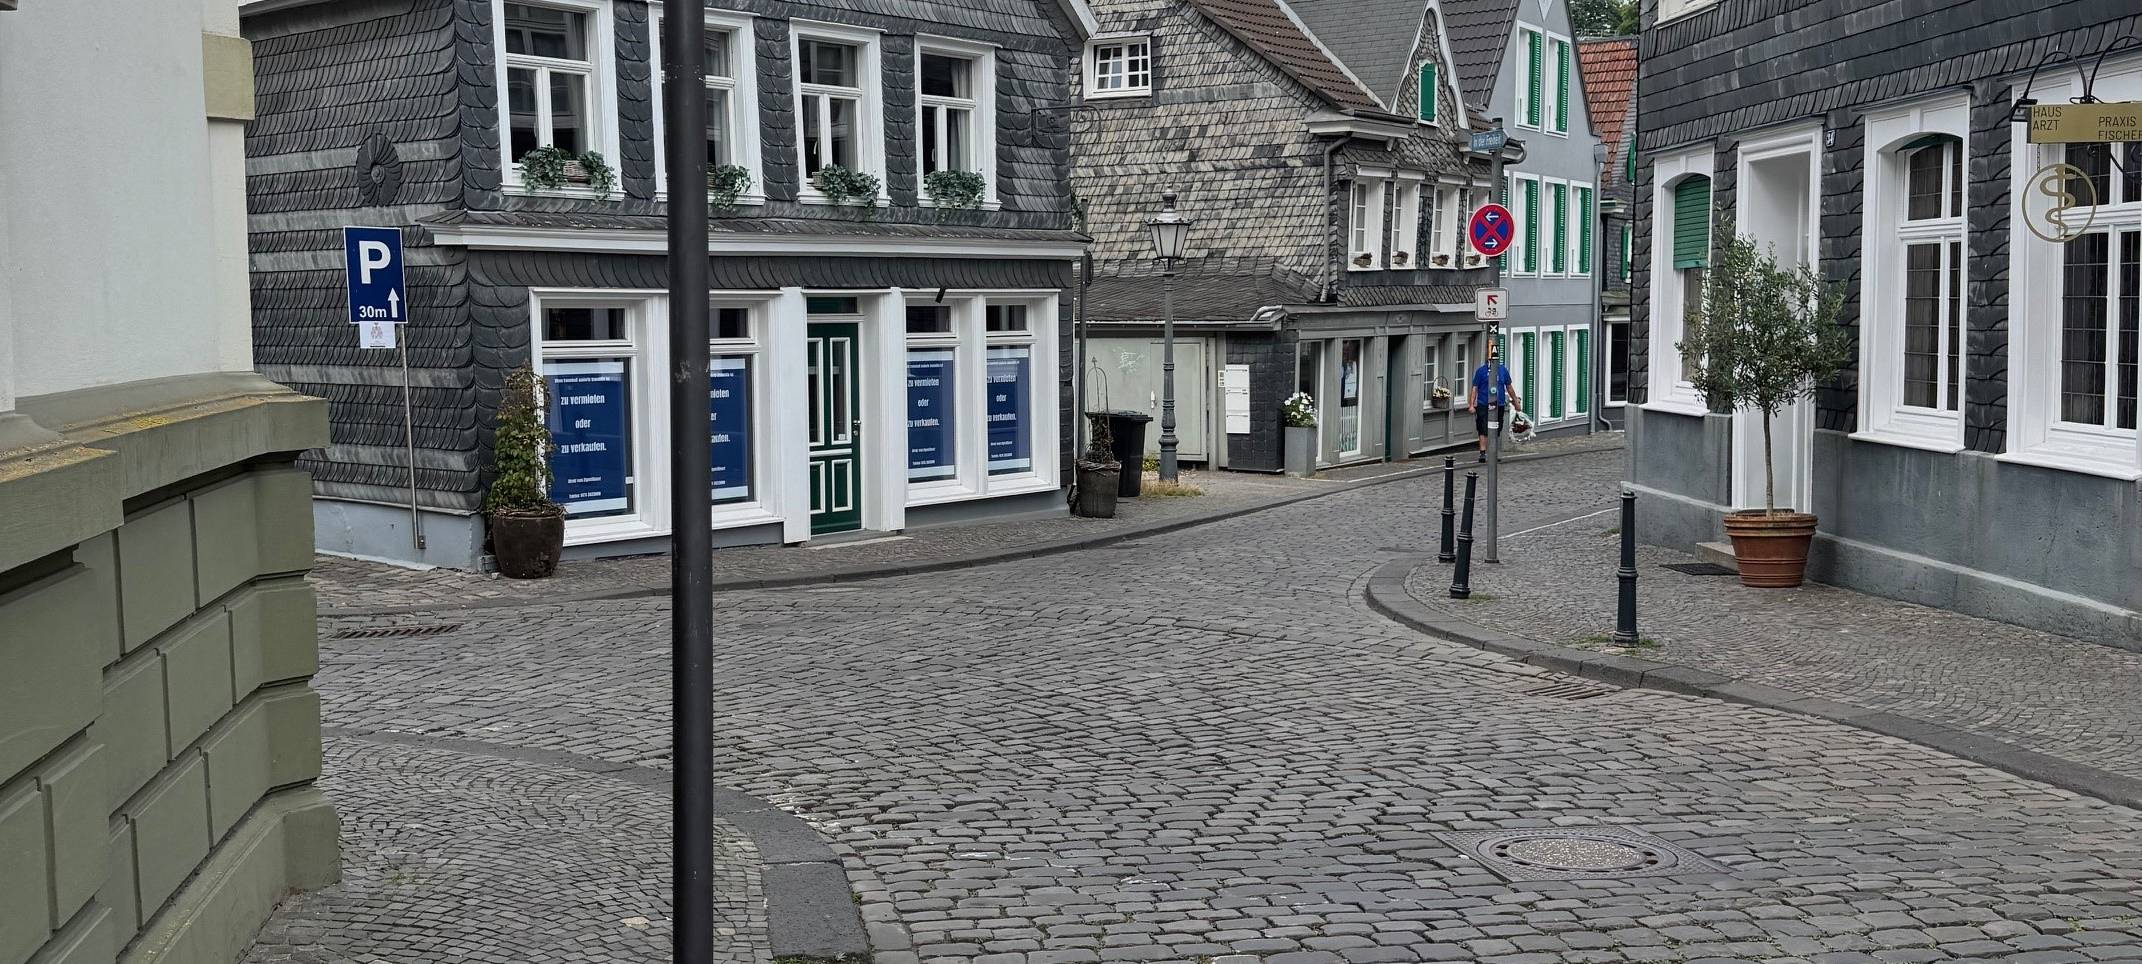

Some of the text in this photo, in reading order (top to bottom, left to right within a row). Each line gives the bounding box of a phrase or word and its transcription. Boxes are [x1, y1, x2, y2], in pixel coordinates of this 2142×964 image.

[2033, 106, 2062, 118] HAUS
[2032, 119, 2060, 131] ARZT
[2098, 116, 2137, 127] PRAXIS
[358, 240, 391, 285] P
[359, 305, 387, 318] 30m
[560, 393, 605, 406] zu vermieten
[917, 398, 929, 407] oder
[996, 394, 1007, 402] oder
[575, 418, 592, 429] oder
[561, 441, 607, 454] zu verkaufen.
